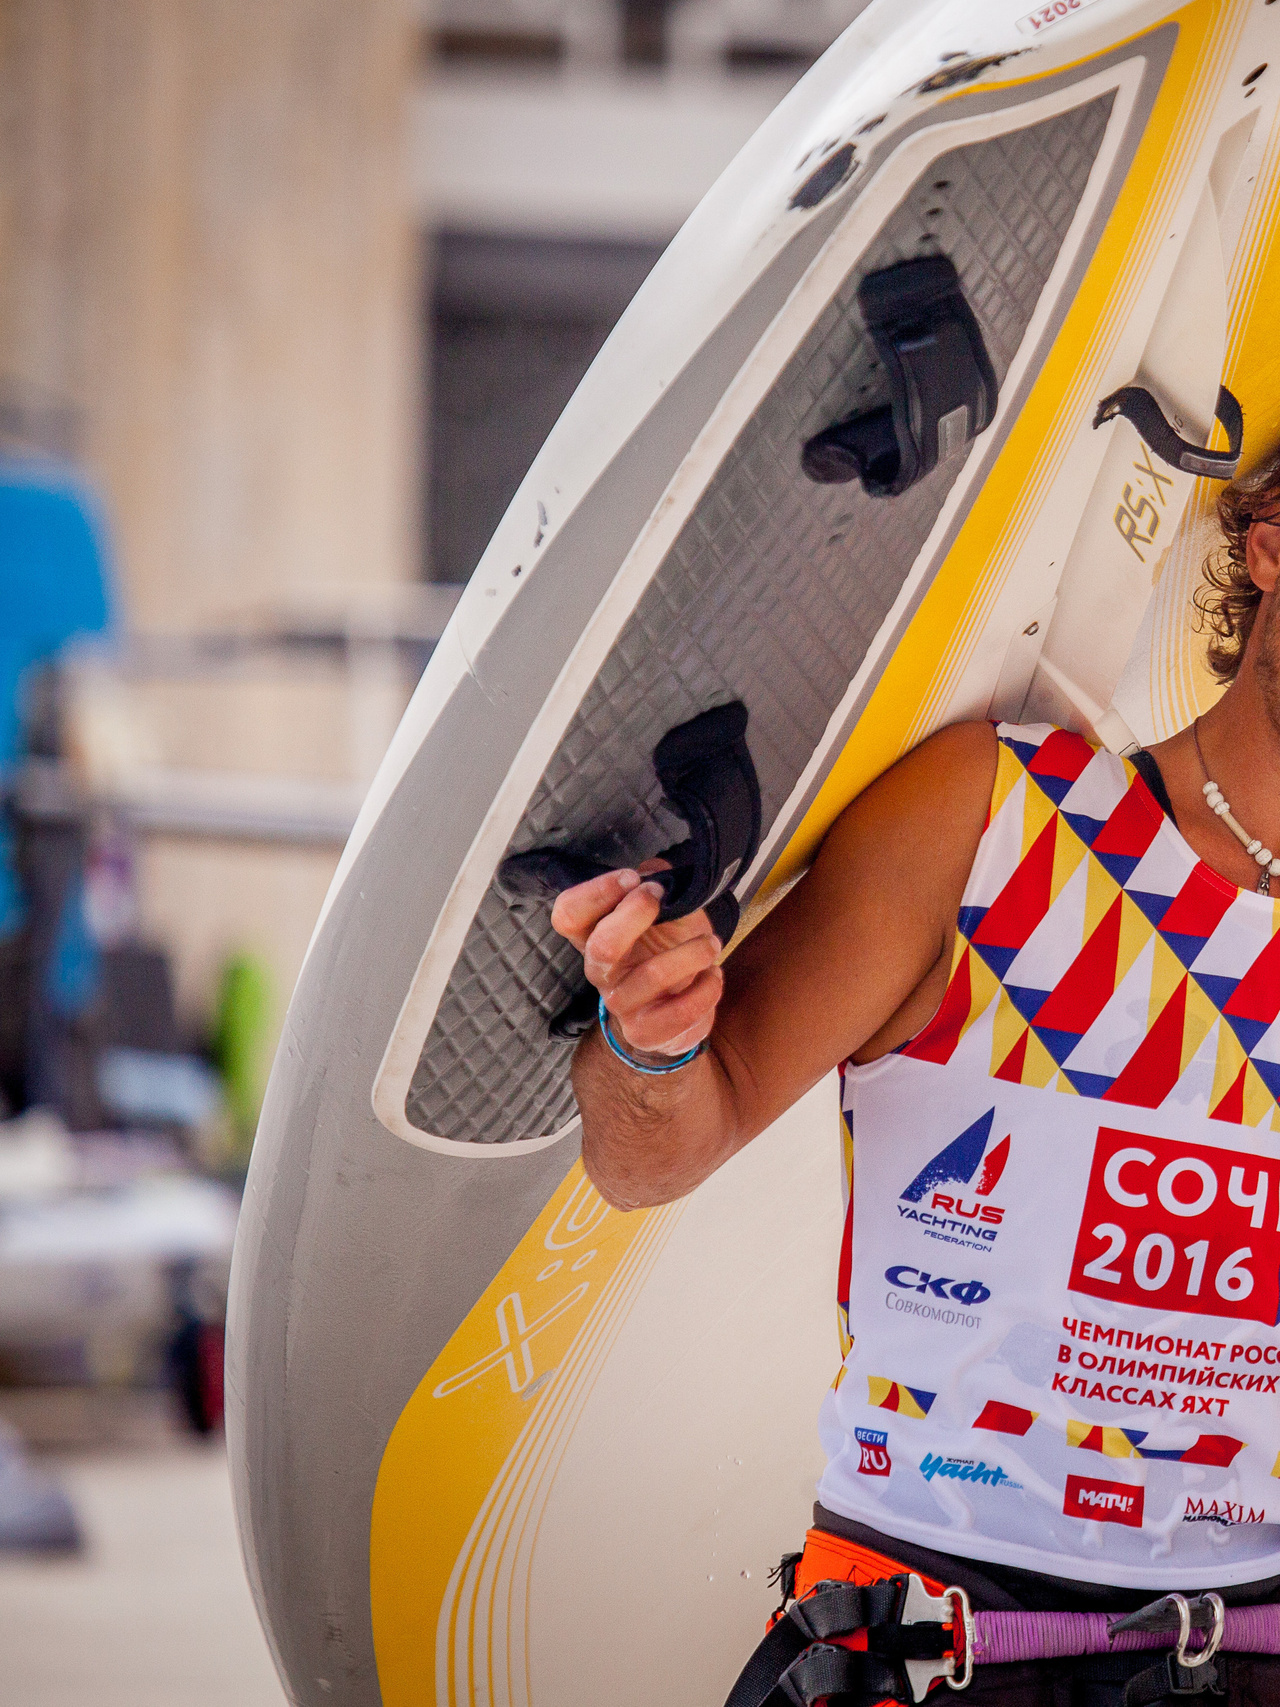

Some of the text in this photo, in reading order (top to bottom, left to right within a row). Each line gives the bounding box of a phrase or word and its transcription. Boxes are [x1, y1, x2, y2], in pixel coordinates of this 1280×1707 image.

[1113, 441, 1174, 563] RS:X
[896, 1204, 998, 1242] YACHTING
[931, 1192, 1006, 1225] RUS
[923, 1229, 993, 1253] FEDERATION
[1082, 1222, 1255, 1302] 2016
[884, 1265, 991, 1307] СКФ
[1062, 1316, 1227, 1362] ЧЕМПИОНАТ
[1057, 1344, 1280, 1394] В ОЛИМПИЙСКИХ
[1051, 1372, 1230, 1418] КЛАССАХ ЯХТ
[856, 1430, 885, 1444] ВЕСТИ
[861, 1446, 888, 1471] RU
[1183, 1496, 1265, 1524] MAXIM
